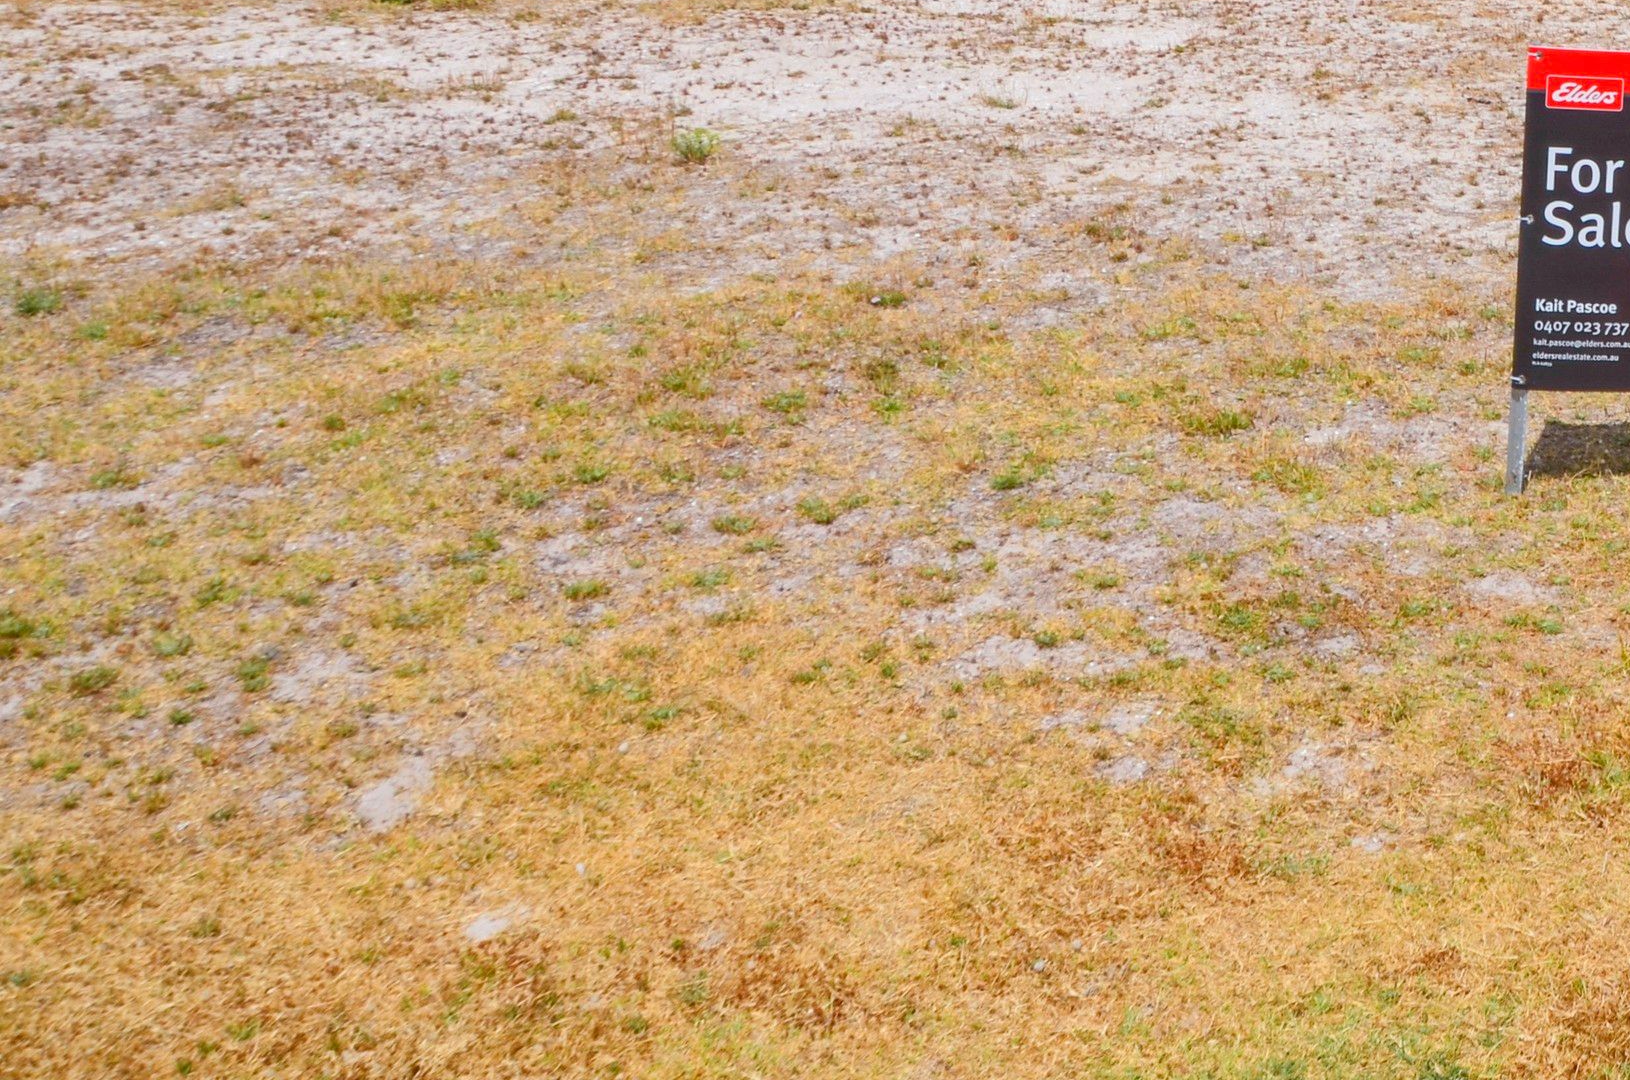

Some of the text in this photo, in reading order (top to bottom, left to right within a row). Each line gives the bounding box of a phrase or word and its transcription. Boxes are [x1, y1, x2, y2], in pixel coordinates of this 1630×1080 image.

[1551, 81, 1619, 105] Elders
[1546, 146, 1625, 194] For
[1535, 298, 1617, 314] Kait Pascoe
[1534, 320, 1630, 335] 0407 023 737
[1532, 351, 1619, 361] eldersrealestate.com.au
